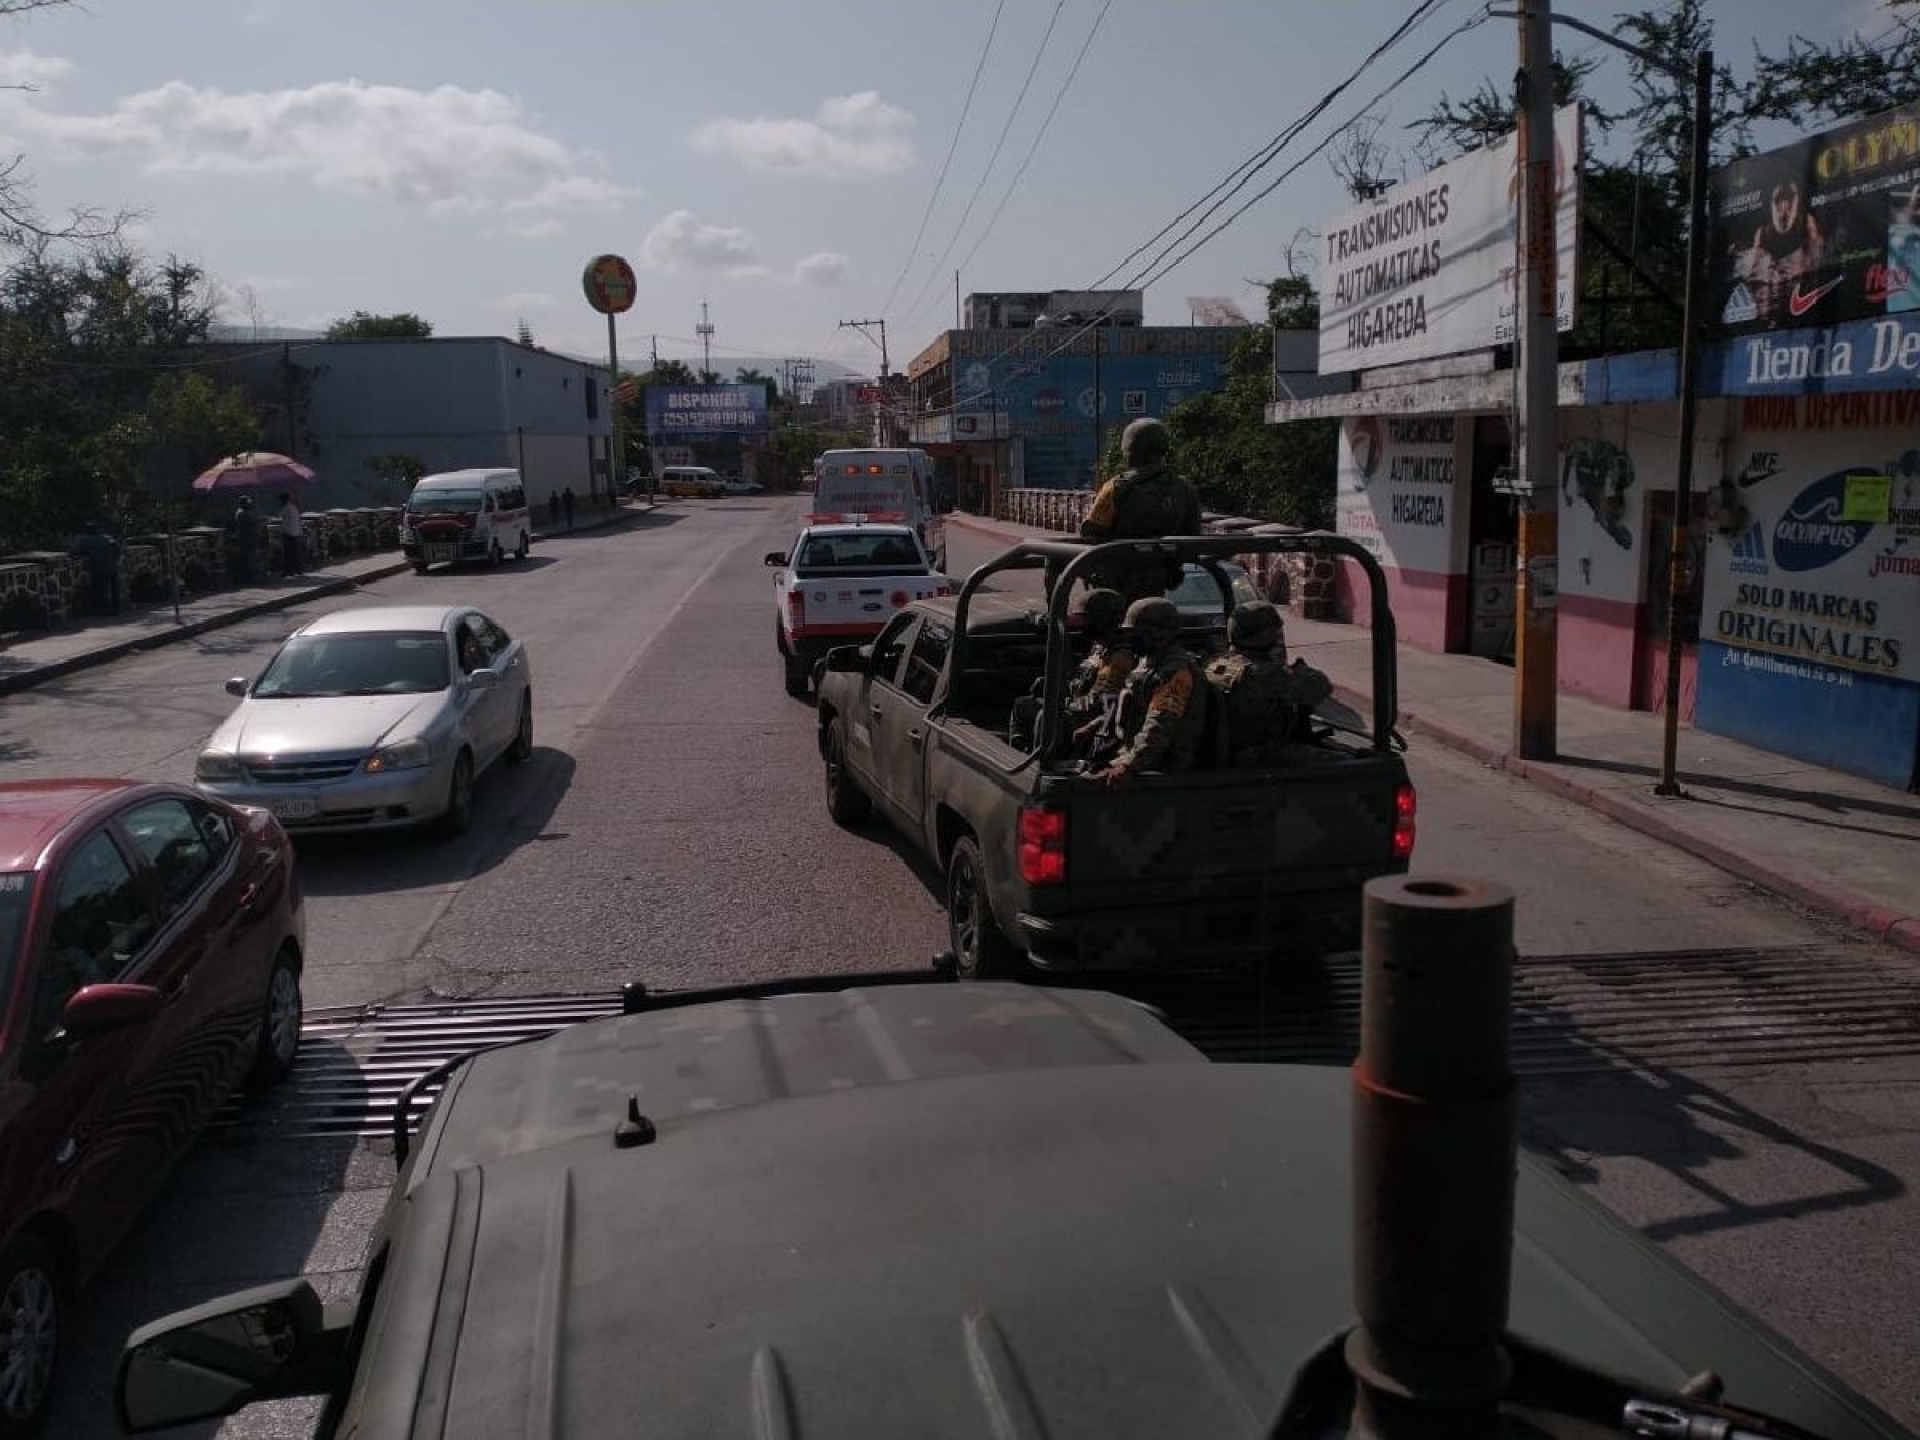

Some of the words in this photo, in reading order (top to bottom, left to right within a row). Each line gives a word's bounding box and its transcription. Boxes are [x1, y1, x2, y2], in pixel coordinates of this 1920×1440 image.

[1327, 184, 1449, 264] TRANSMISIONES
[1335, 240, 1441, 304] AUTOMATICAS
[1347, 295, 1427, 350] HIGAREDA
[1747, 328, 1853, 384] Tienda
[1868, 320, 1920, 378] De
[1390, 456, 1454, 483] AUTOMATICAS
[1750, 452, 1780, 474] NIKE
[1392, 493, 1445, 527] HIGAREDA
[1777, 520, 1857, 547] OLYMPUS
[1730, 561, 1769, 576] adidas
[1738, 583, 1784, 610] SOLO
[1790, 589, 1879, 626] MARCAS
[1718, 610, 1901, 669] ORIGINALES
